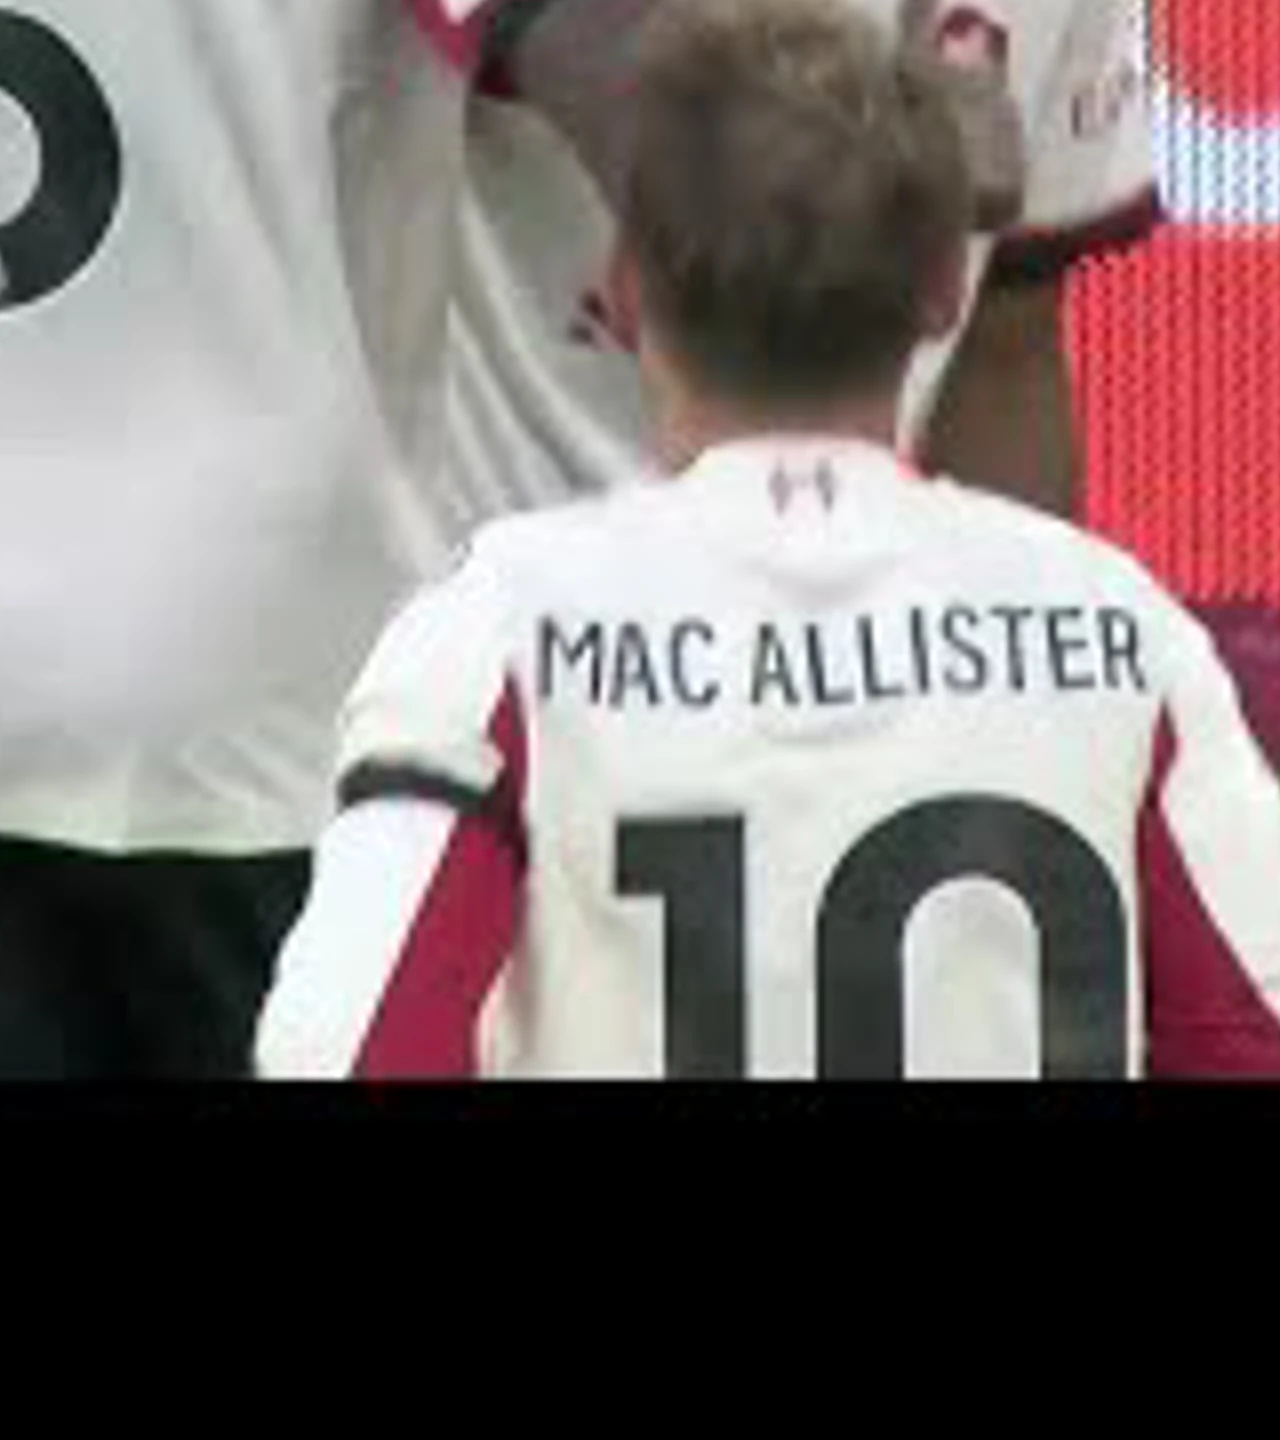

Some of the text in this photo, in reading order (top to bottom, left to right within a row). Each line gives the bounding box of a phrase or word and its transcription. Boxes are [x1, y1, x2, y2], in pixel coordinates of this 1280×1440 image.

[535, 604, 1148, 709] MAC ALLISTER
[613, 791, 1128, 1079] 10
